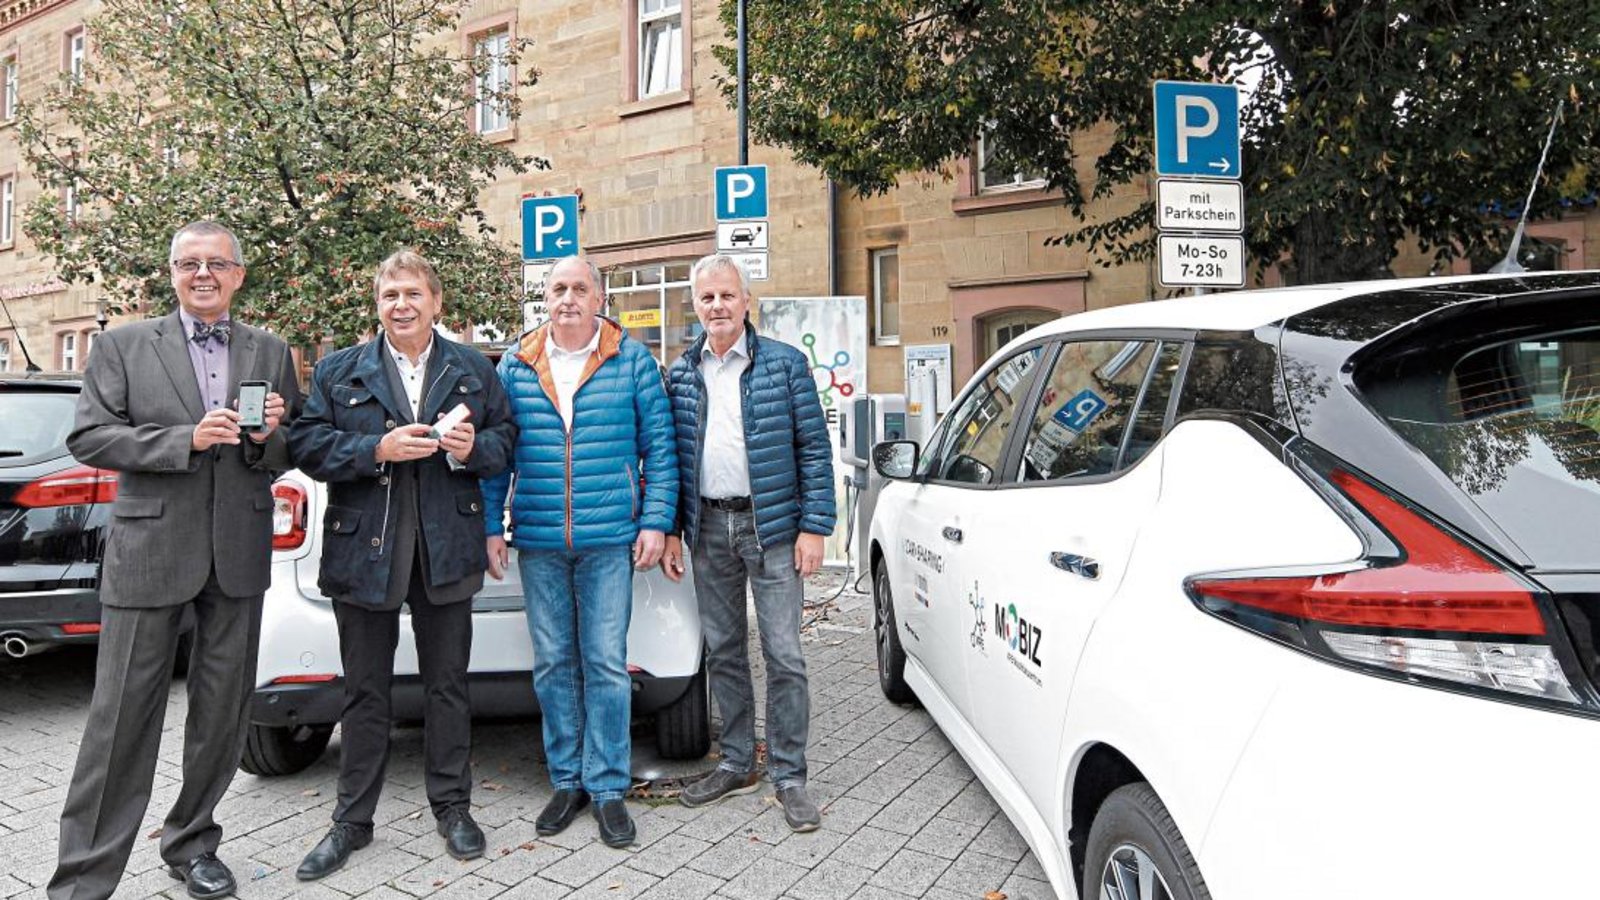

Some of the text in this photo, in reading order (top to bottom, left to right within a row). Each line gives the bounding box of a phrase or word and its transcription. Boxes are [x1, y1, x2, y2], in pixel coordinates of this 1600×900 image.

[1175, 94, 1219, 164] P
[726, 172, 756, 214] P
[1189, 192, 1211, 204] mit
[1164, 206, 1236, 221] Parkschein
[534, 204, 565, 252] P
[1177, 243, 1228, 260] Mo-So
[1180, 262, 1223, 278] 7-23h
[931, 325, 948, 338] 119
[994, 602, 1042, 668] MOBIZ
